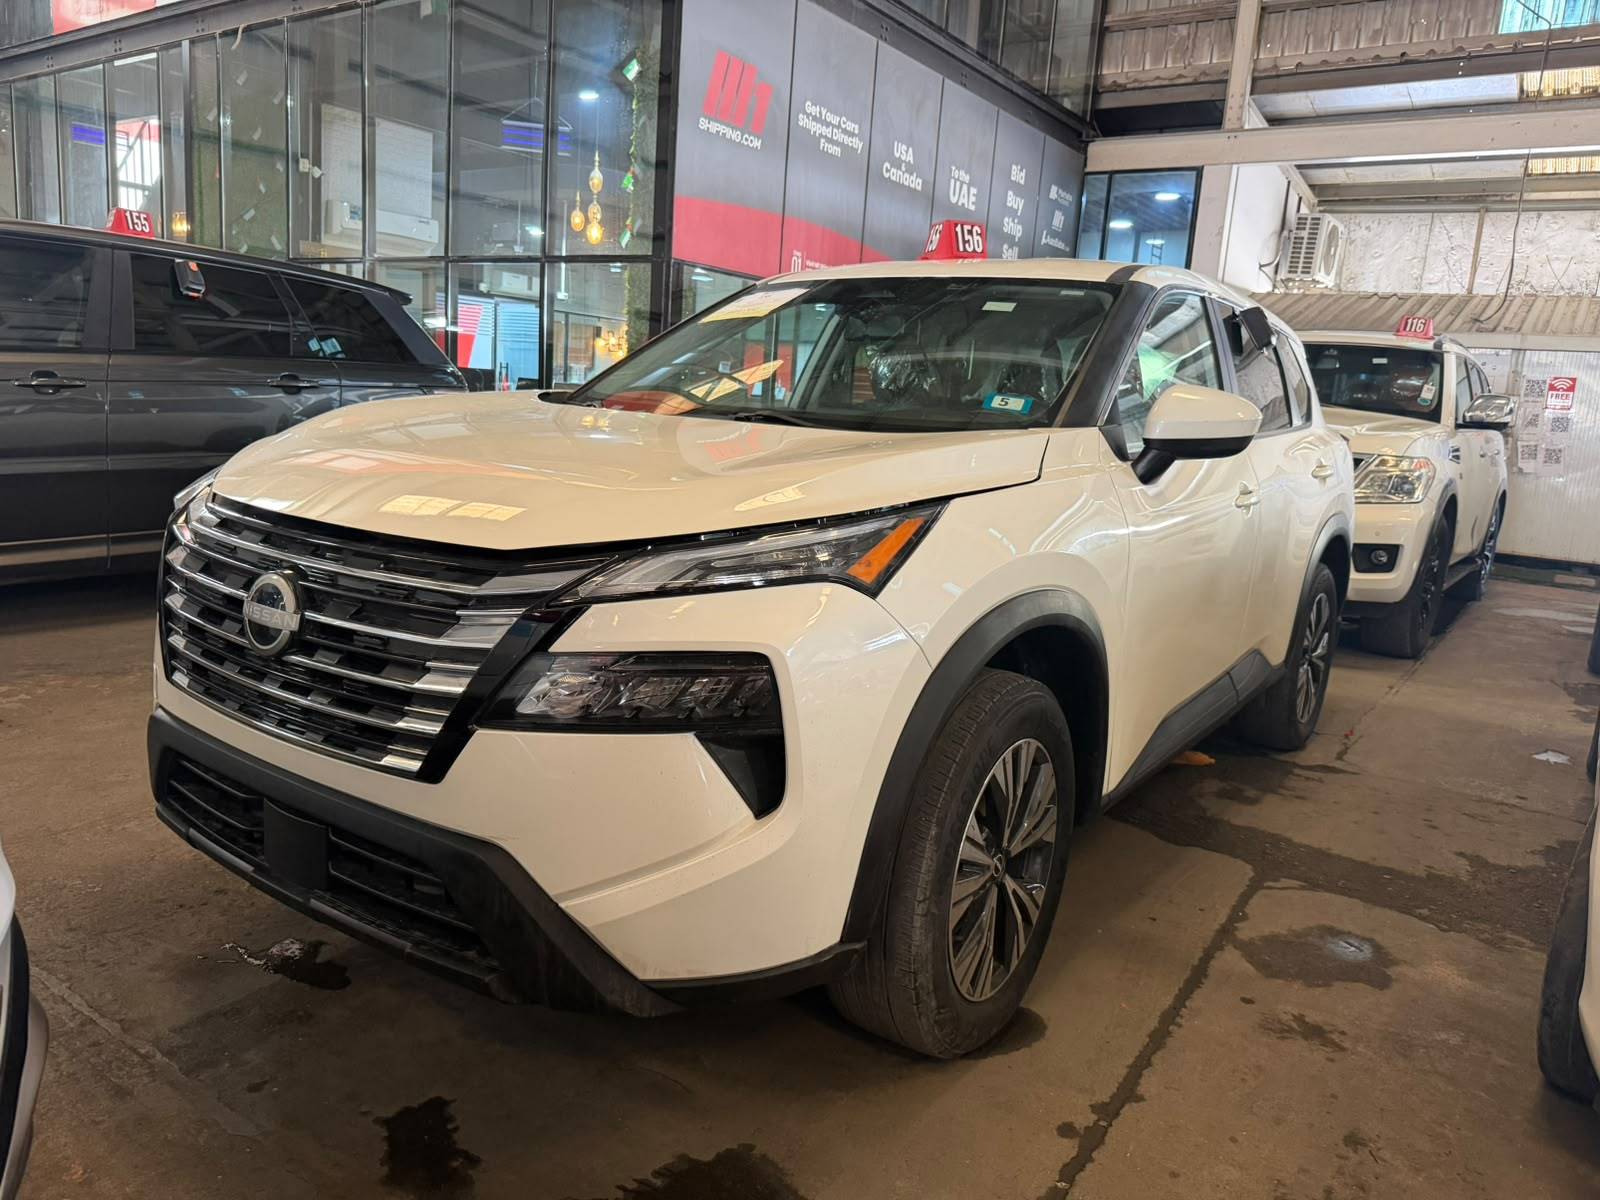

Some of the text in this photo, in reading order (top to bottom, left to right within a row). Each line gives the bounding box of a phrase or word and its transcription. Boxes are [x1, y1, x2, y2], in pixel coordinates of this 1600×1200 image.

[805, 100, 860, 135] Get Your Cars
[698, 117, 763, 150] SHIPPING.COM
[798, 113, 864, 154] Shipped Directly
[820, 138, 842, 158] From
[894, 140, 914, 164] USA
[882, 161, 923, 192] Canada
[950, 165, 970, 184] To the
[1010, 164, 1026, 185] Bid
[949, 178, 977, 212] UAE
[1006, 190, 1025, 216] Buy
[125, 210, 150, 233] 155
[1002, 216, 1023, 242] Ship
[955, 223, 983, 253] 156
[1002, 243, 1019, 260] Sell
[1405, 318, 1426, 333] 116
[998, 397, 1010, 407] 5
[1550, 392, 1572, 401] FREE
[245, 601, 298, 629] NISSAN
